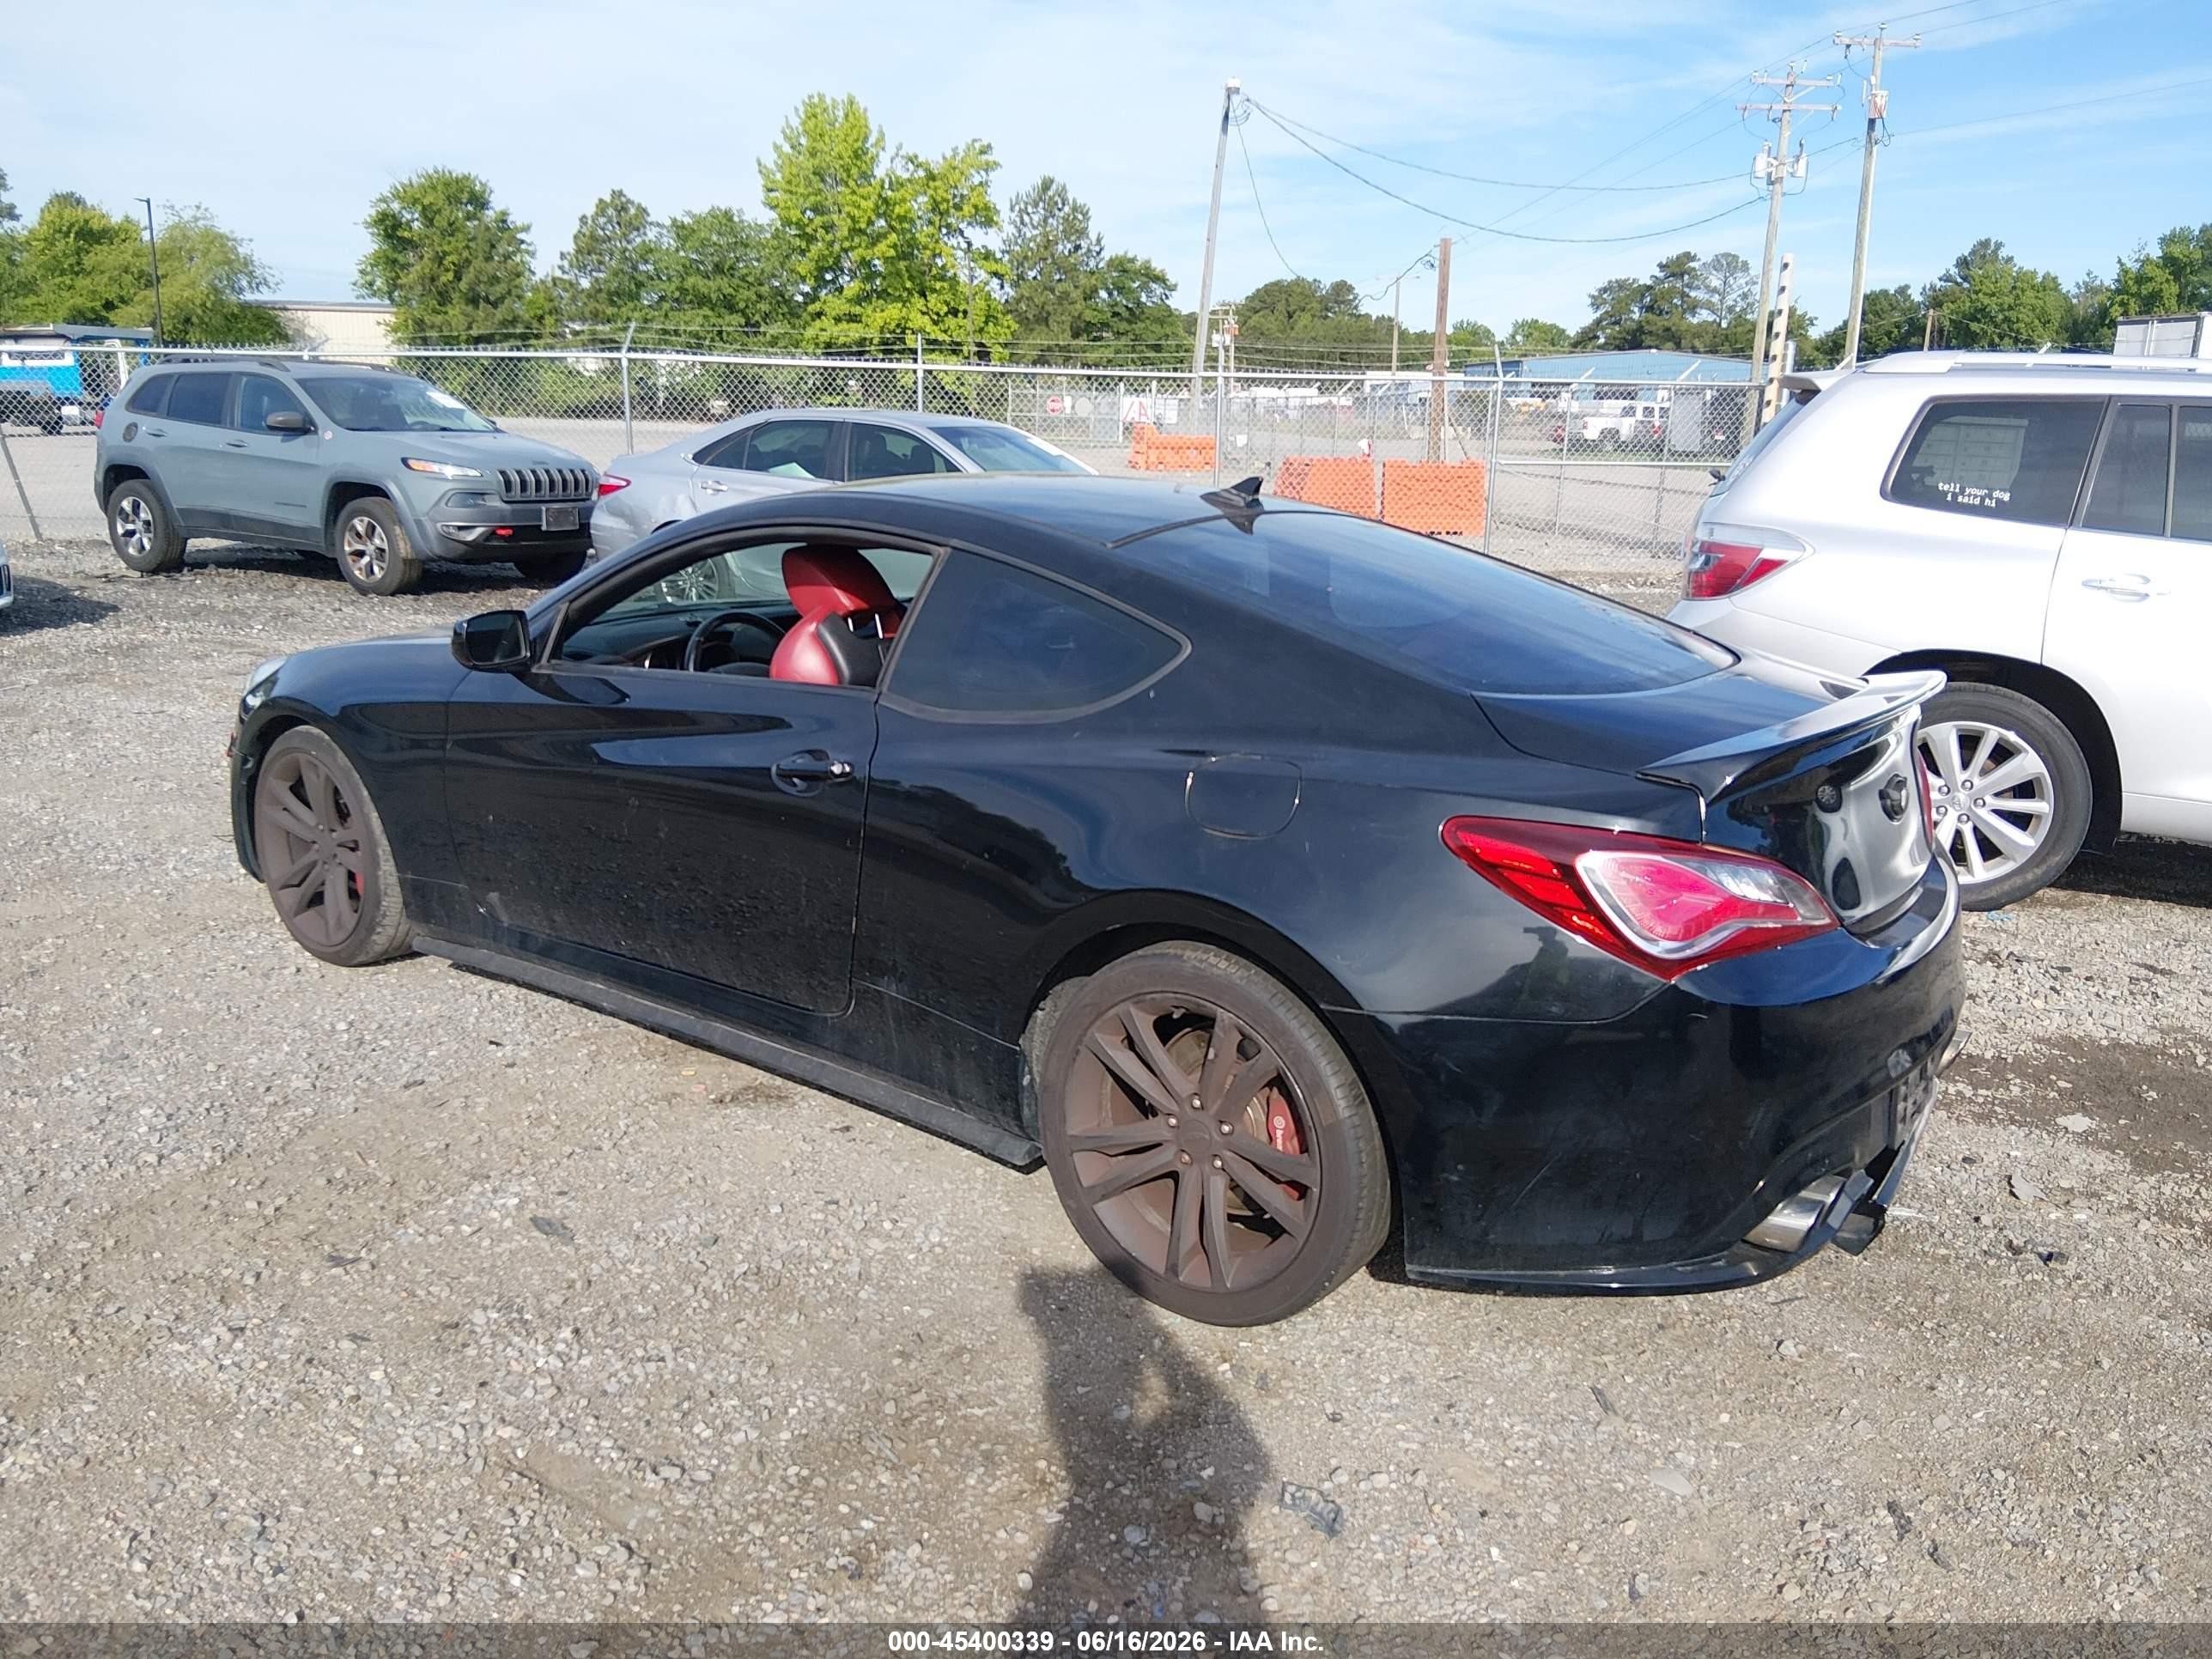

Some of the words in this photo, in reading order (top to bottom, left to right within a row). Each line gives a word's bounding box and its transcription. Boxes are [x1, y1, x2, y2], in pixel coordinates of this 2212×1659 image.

[1938, 482, 1960, 493] tell
[1964, 487, 1988, 496] your
[1992, 489, 2011, 501] dog
[1946, 492, 1953, 501] i
[1957, 495, 1981, 505] said
[1984, 498, 1996, 508] hi
